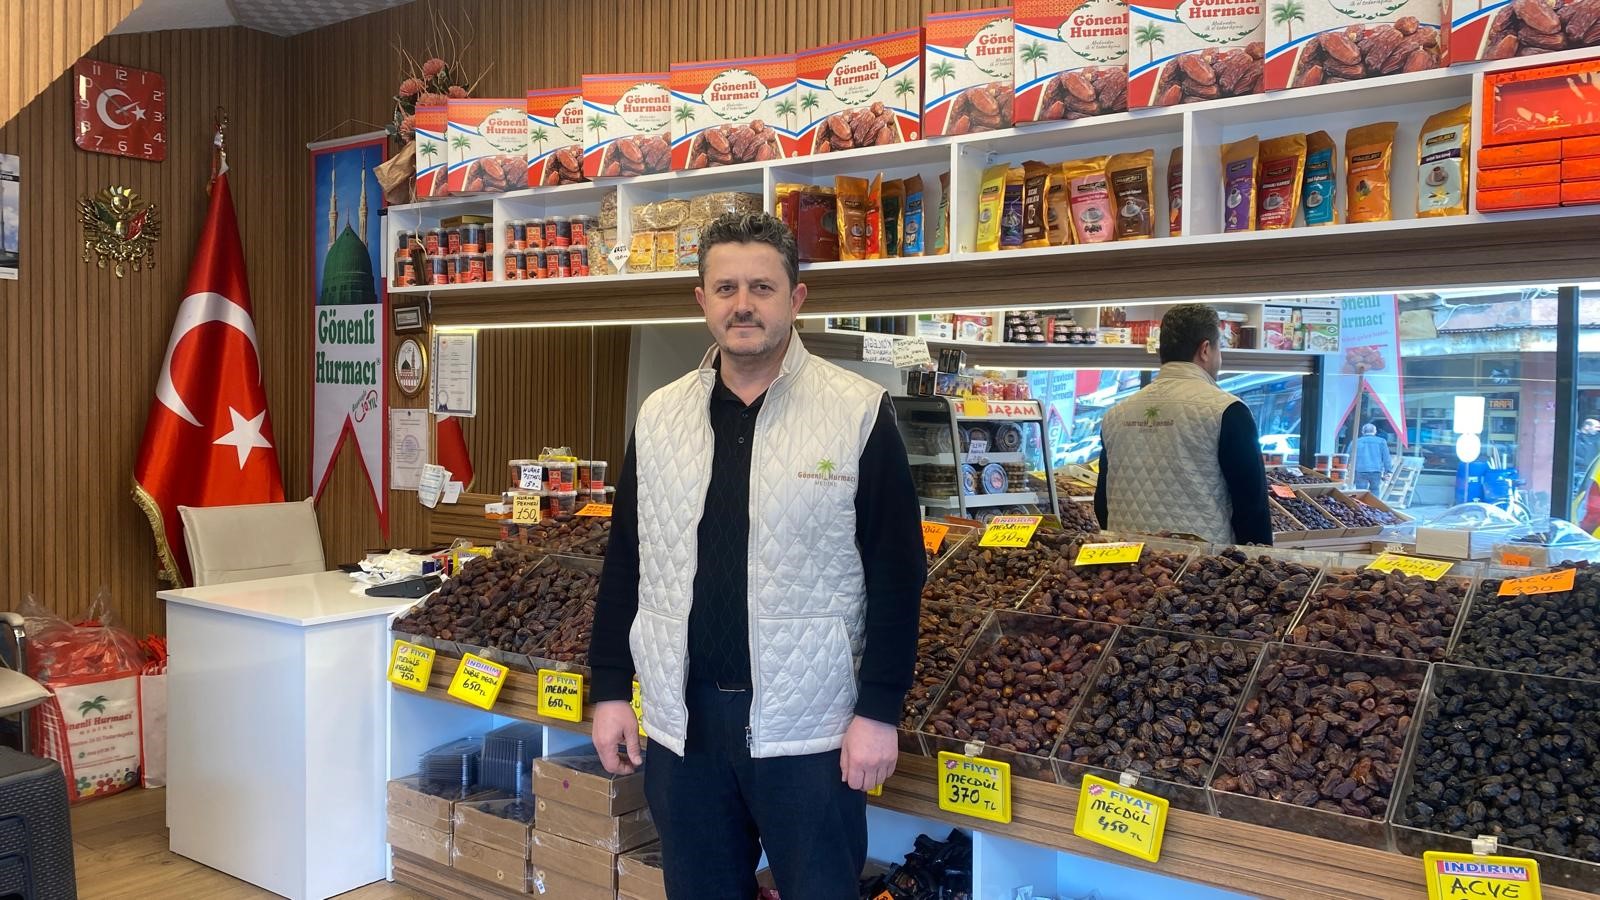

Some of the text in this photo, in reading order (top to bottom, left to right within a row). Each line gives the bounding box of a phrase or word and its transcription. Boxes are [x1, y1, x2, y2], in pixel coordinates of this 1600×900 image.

[1188, 5, 1260, 19] Hurmacı
[92, 65, 101, 76] 11
[835, 61, 877, 76] Gönenli
[115, 69, 128, 81] 12
[833, 72, 880, 87] Hurmacı
[712, 81, 757, 92] Gönenli
[153, 90, 161, 101] 2
[710, 91, 759, 102] Hurmacı
[154, 111, 162, 122] 3
[94, 135, 104, 146] 7
[153, 132, 162, 143] 4
[118, 140, 127, 151] 6
[143, 143, 152, 154] 5
[318, 308, 375, 345] Gönenli
[316, 351, 377, 385] Hurmacı
[400, 671, 414, 681] 750
[963, 762, 999, 775] FIYAT
[948, 784, 997, 810] 370 TL
[1110, 791, 1153, 810] FIYAT
[1090, 799, 1151, 825] MECDÜL
[1130, 832, 1142, 842] TL
[1444, 862, 1525, 874] INDIRIM
[1450, 877, 1521, 899] ACVE
